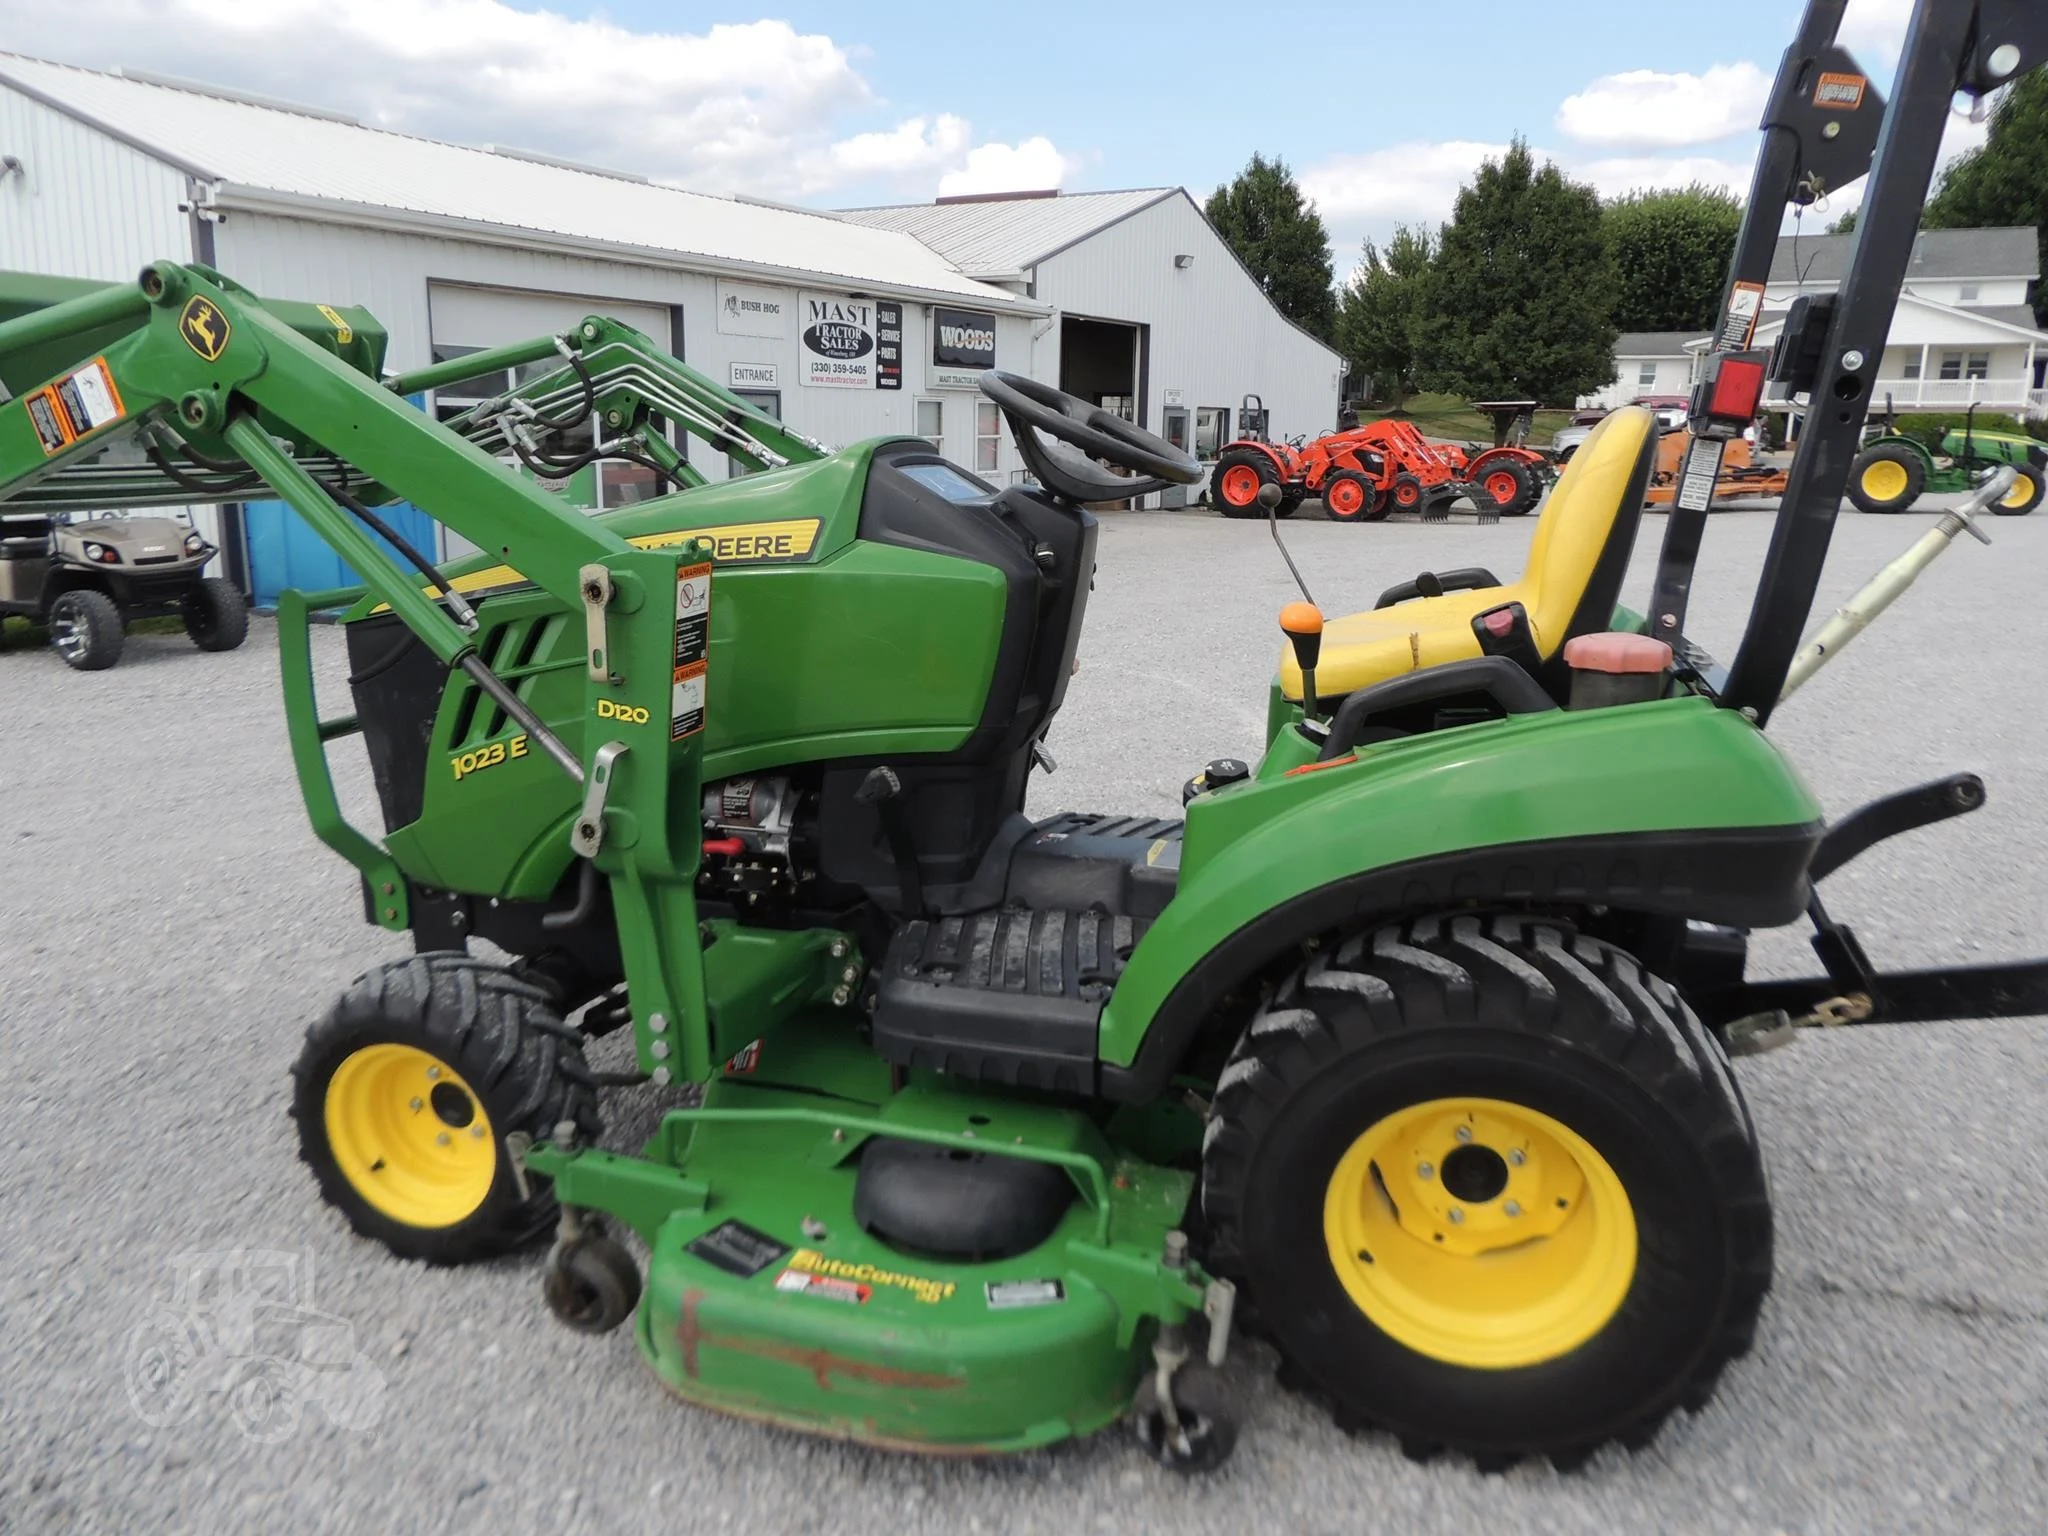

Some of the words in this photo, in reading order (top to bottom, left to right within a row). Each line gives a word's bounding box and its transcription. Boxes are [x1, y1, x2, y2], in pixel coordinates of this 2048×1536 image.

[741, 300, 761, 312] BUSH
[763, 303, 780, 314] HOG
[809, 300, 871, 326] MAST
[881, 311, 896, 324] SALES
[815, 322, 862, 340] TRACTOR
[881, 329, 900, 342] SERVICE
[940, 325, 994, 351] WOODS
[821, 336, 859, 350] SALES
[881, 347, 896, 359] PARTS
[734, 368, 774, 382] ENTRANCE
[811, 362, 831, 374] (330)
[832, 363, 867, 375] 359-5405
[811, 375, 868, 385] www.masttractor.com
[684, 564, 710, 577] WARNING
[680, 664, 705, 679] WARNING
[597, 699, 649, 724] D120
[450, 743, 506, 780] 1023
[510, 734, 528, 759] E
